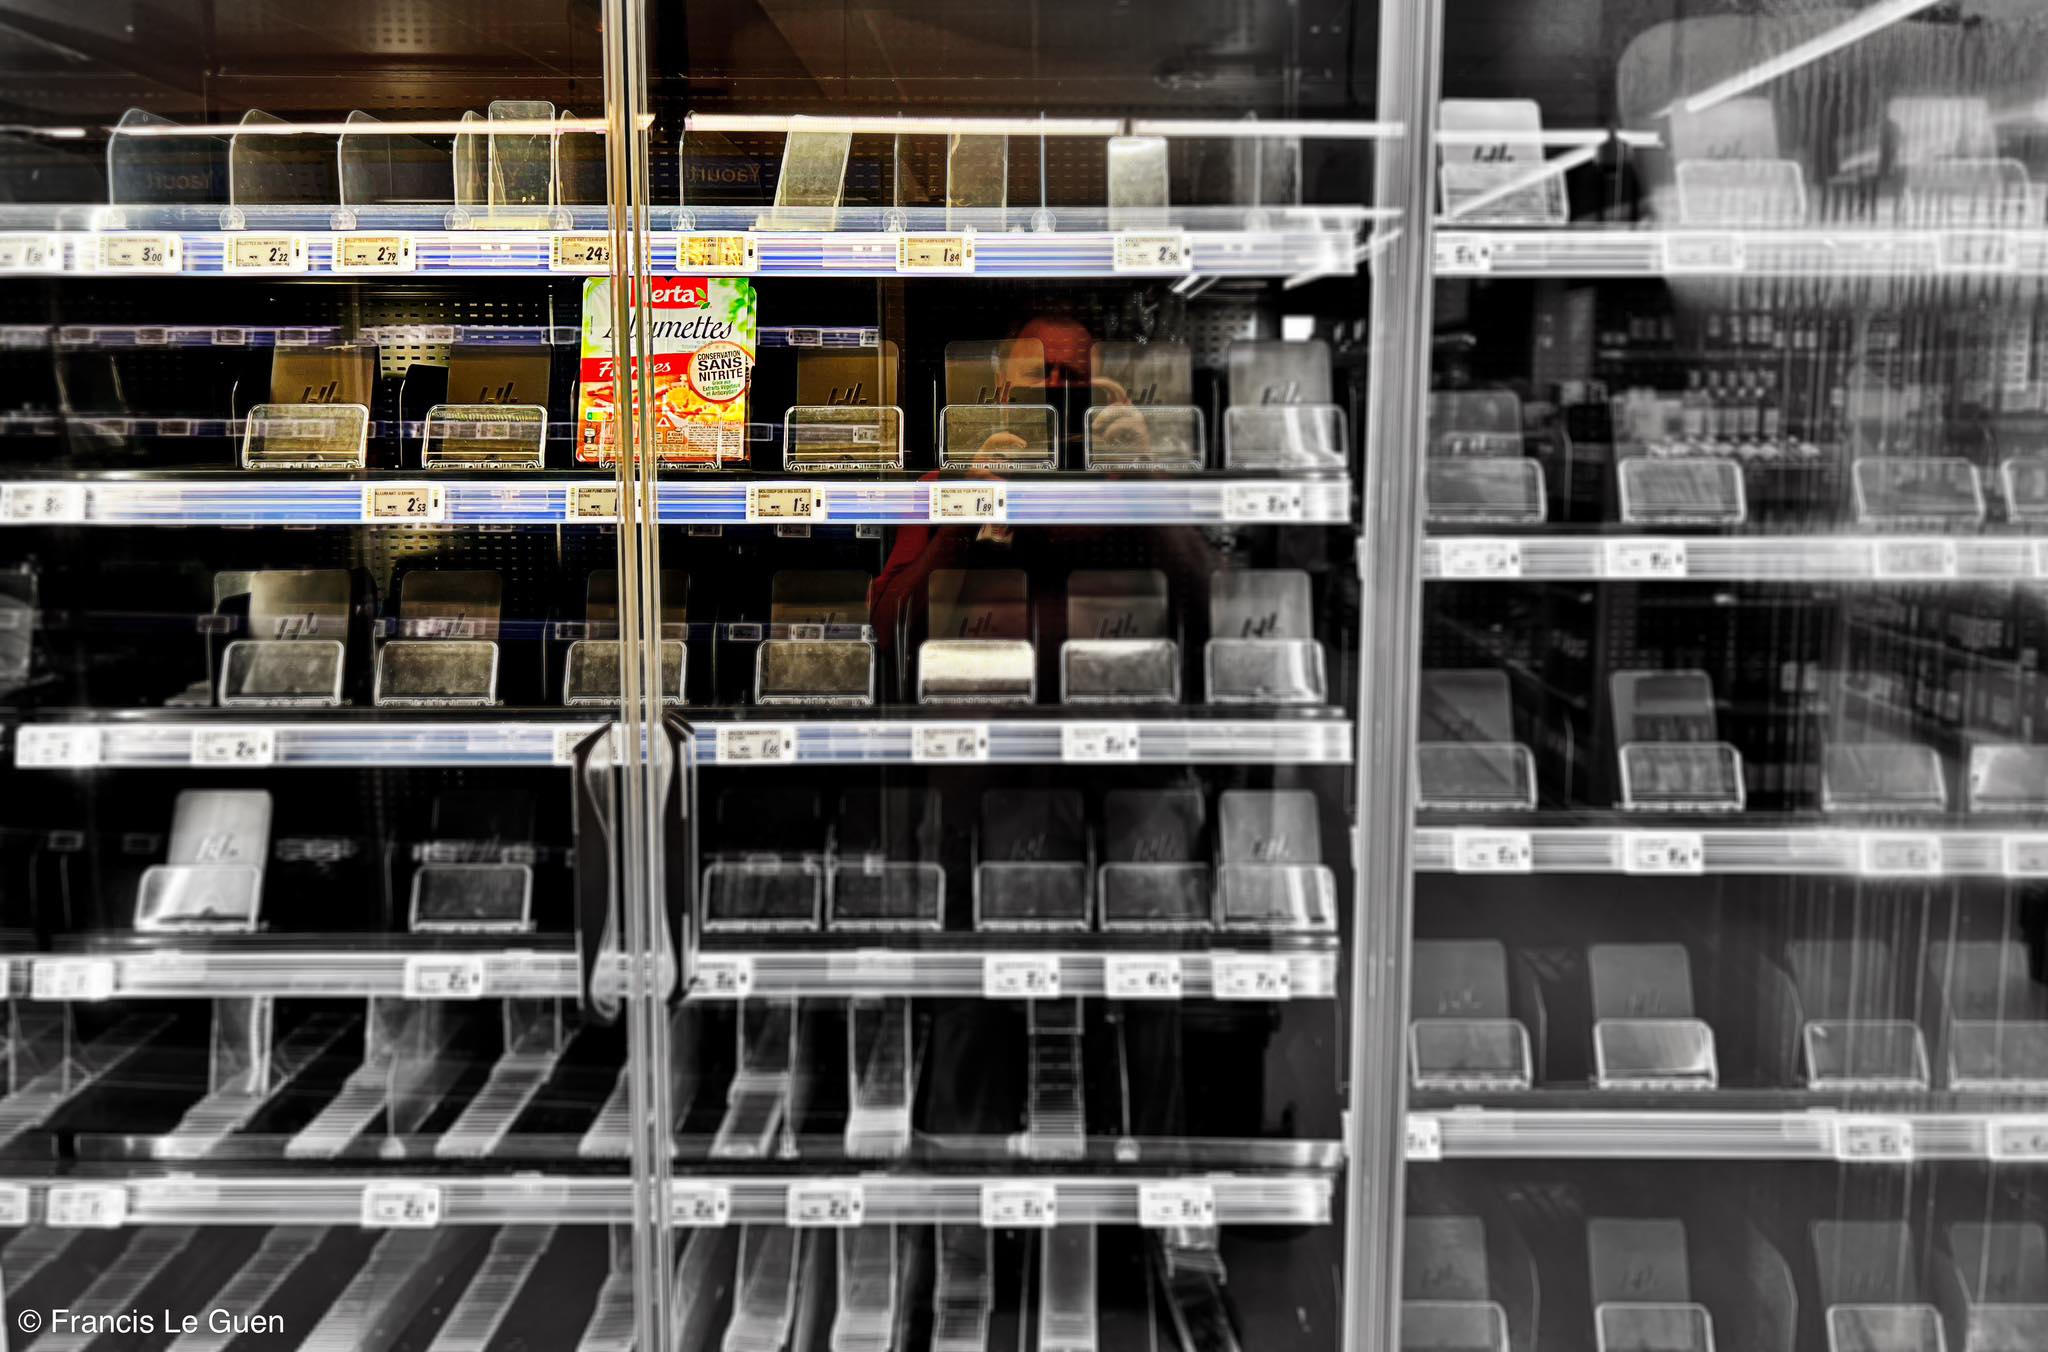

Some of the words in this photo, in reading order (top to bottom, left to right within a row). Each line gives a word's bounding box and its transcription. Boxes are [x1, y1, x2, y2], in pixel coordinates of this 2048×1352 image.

[697, 350, 741, 362] CONSERVATION
[698, 357, 742, 372] SANS
[699, 368, 743, 383] NITRITE
